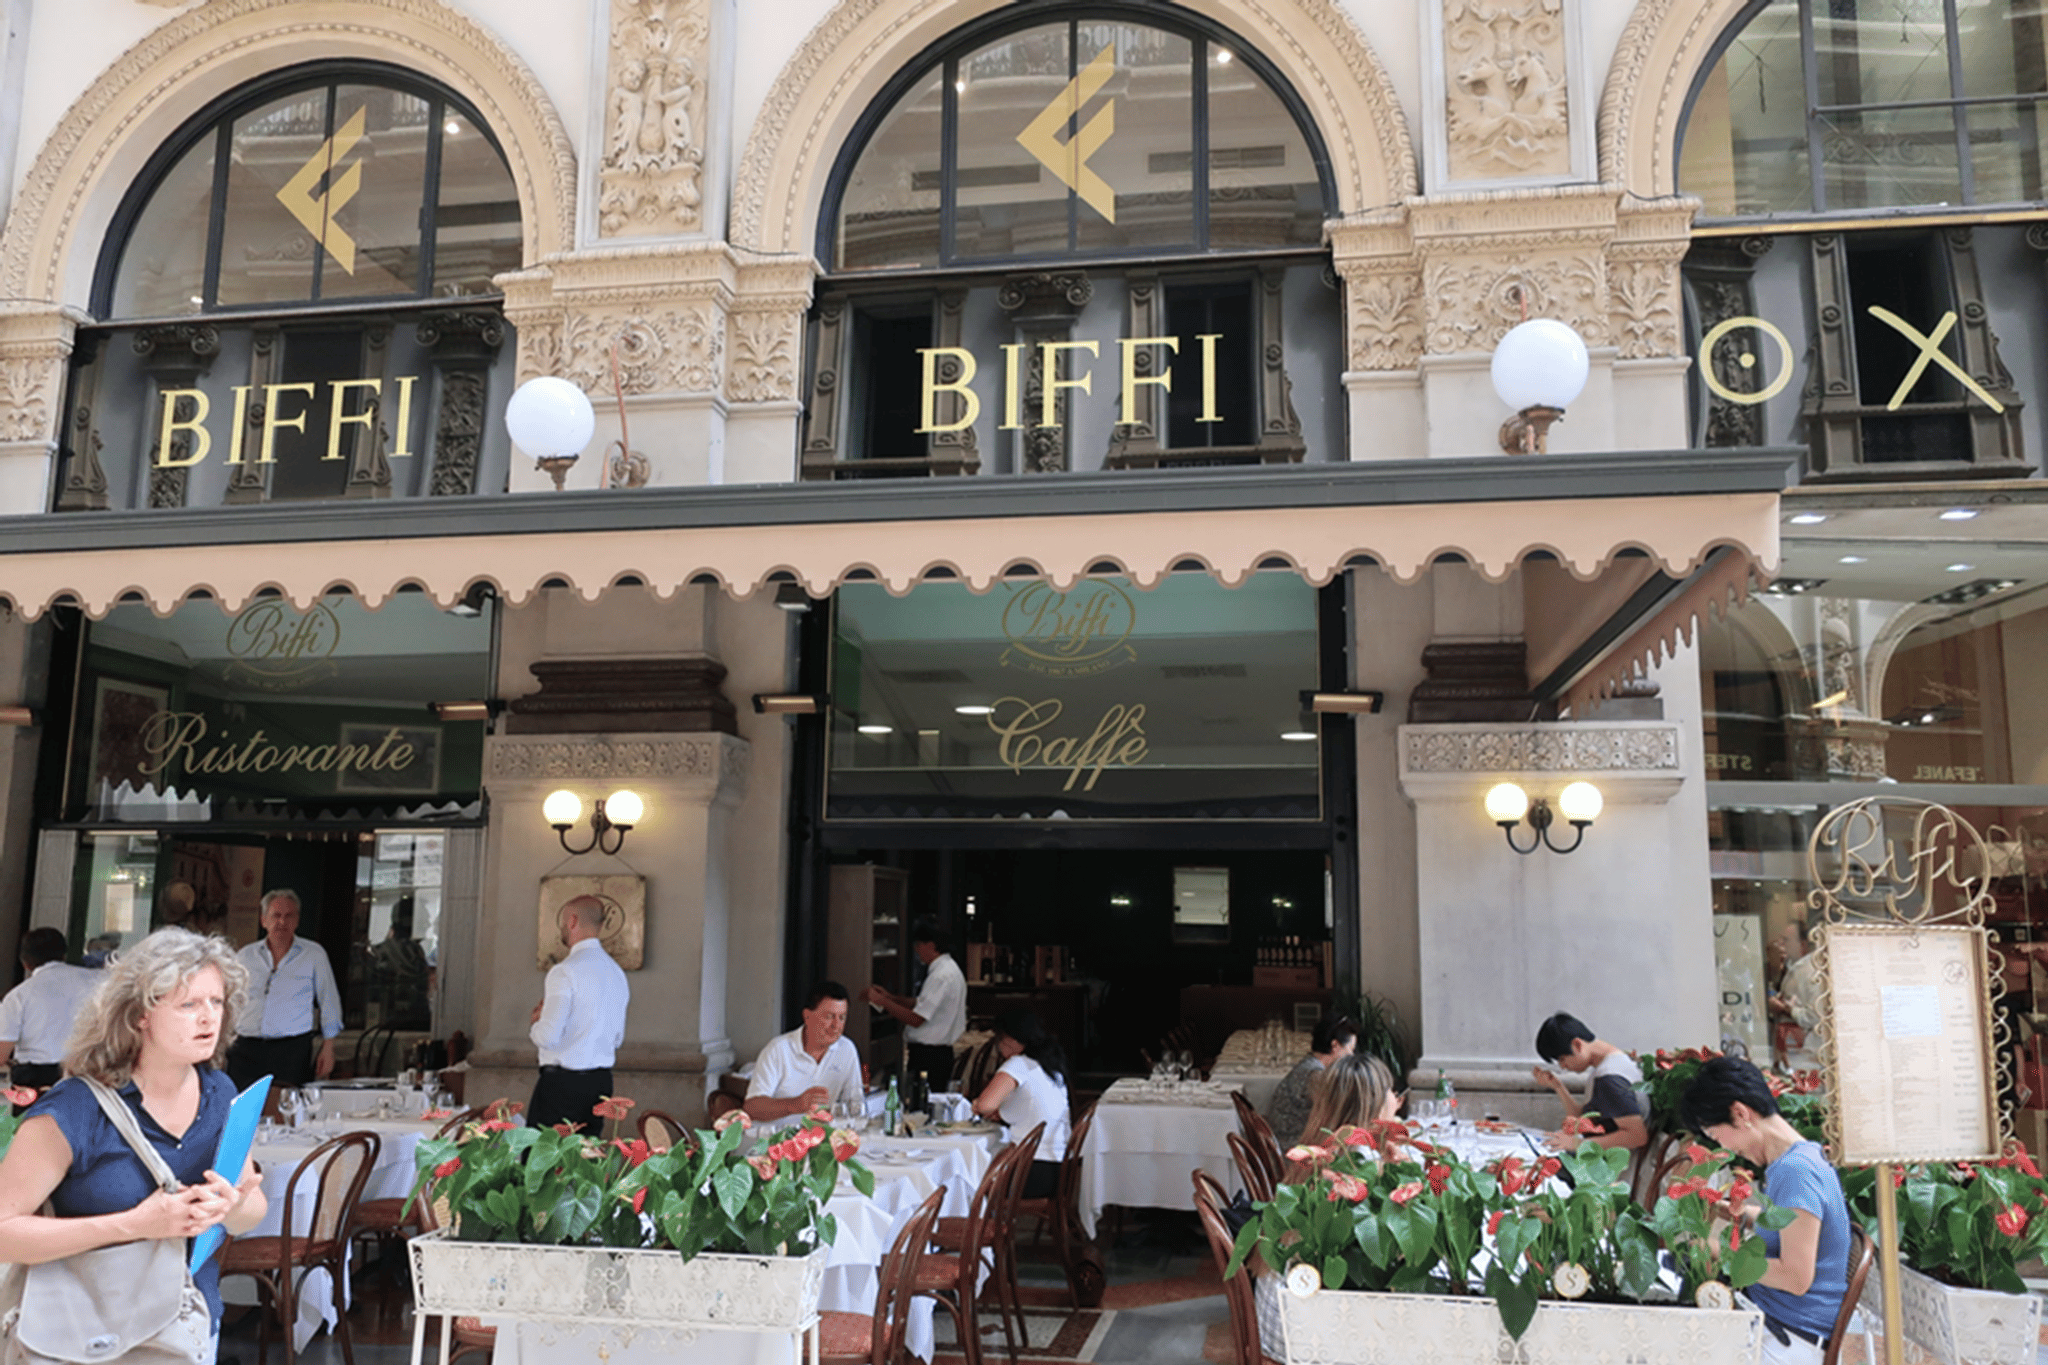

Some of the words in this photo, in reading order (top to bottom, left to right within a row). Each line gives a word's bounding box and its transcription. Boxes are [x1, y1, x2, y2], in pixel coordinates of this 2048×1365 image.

[913, 333, 1225, 434] BIFFI
[153, 375, 419, 469] BIFFI
[238, 604, 326, 668] Biffi
[1017, 585, 1117, 656] Biffi
[137, 710, 416, 776] Ristorante
